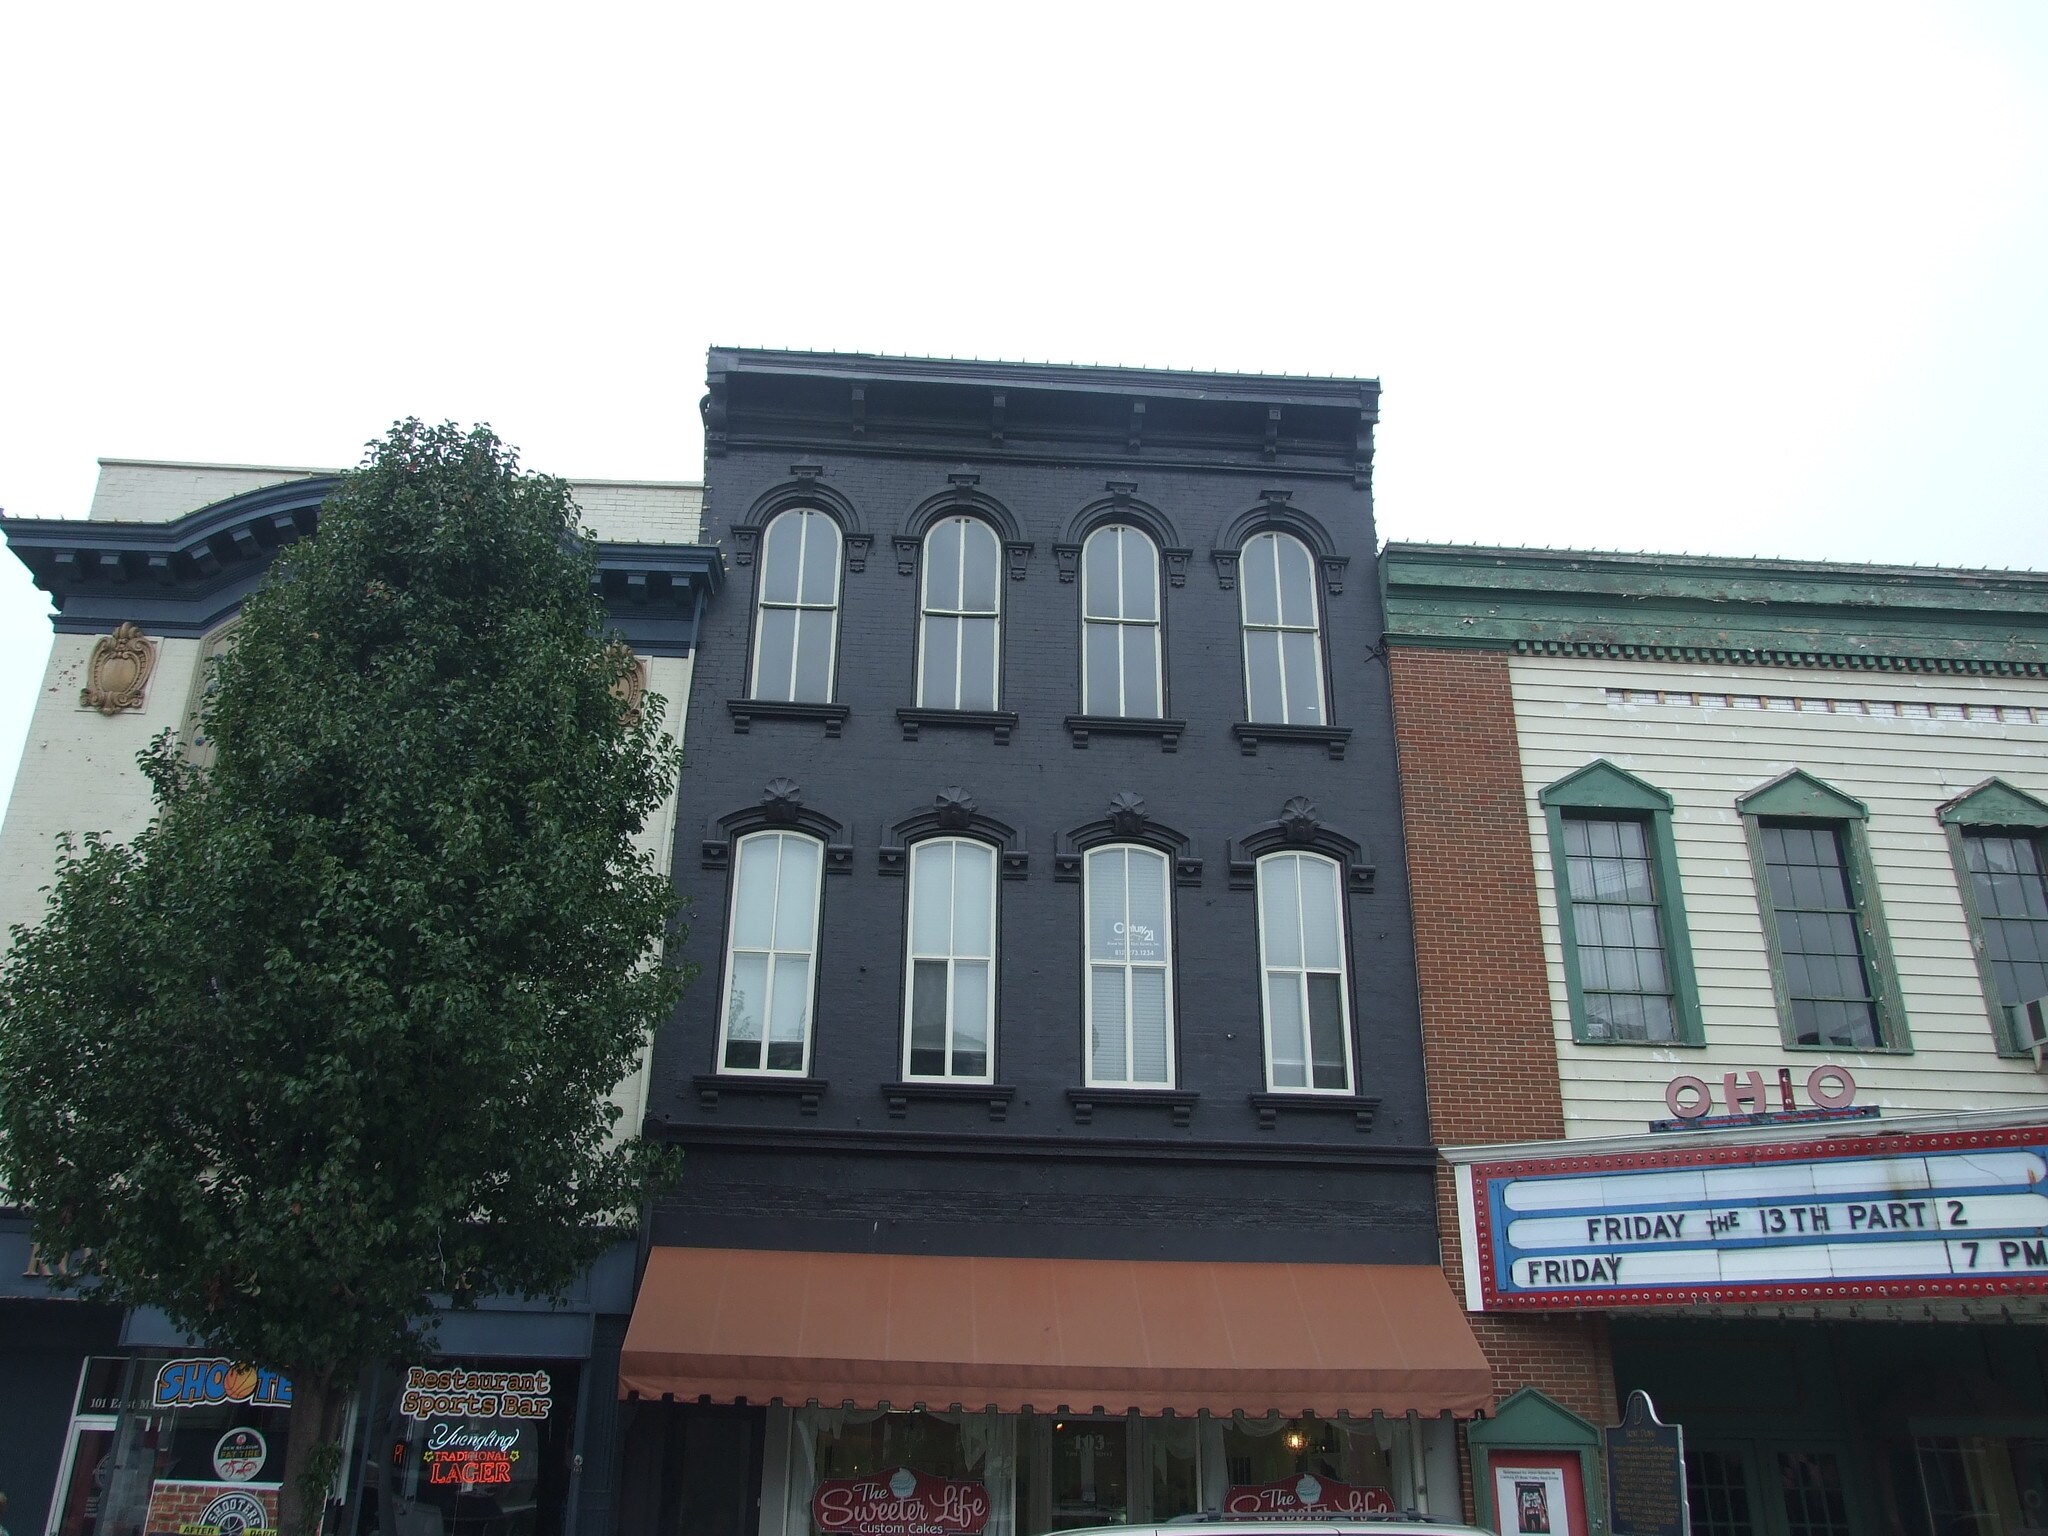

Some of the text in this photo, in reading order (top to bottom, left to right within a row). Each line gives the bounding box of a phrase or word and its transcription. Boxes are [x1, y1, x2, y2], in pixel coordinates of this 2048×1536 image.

[1143, 930, 1154, 941] 21
[1666, 1064, 1856, 1118] OHIO
[1587, 1200, 1968, 1241] FRIDAY THE 13TH PART 2
[1528, 1240, 2048, 1284] FRIDAY 7 PM
[408, 1368, 550, 1393] Restaurant
[90, 1398, 106, 1408] 101
[403, 1392, 550, 1418] Sports Bar
[428, 1423, 520, 1451] Yuengling
[434, 1451, 509, 1462] TRADITIONAL
[430, 1462, 511, 1485] LAGER
[852, 1482, 889, 1501] The
[1260, 1489, 1296, 1508] The
[208, 1499, 260, 1526] SHOOTERS
[820, 1485, 987, 1528] Sweeter Life
[183, 1526, 215, 1535] AFTER
[859, 1522, 943, 1535] Custom Cakes
